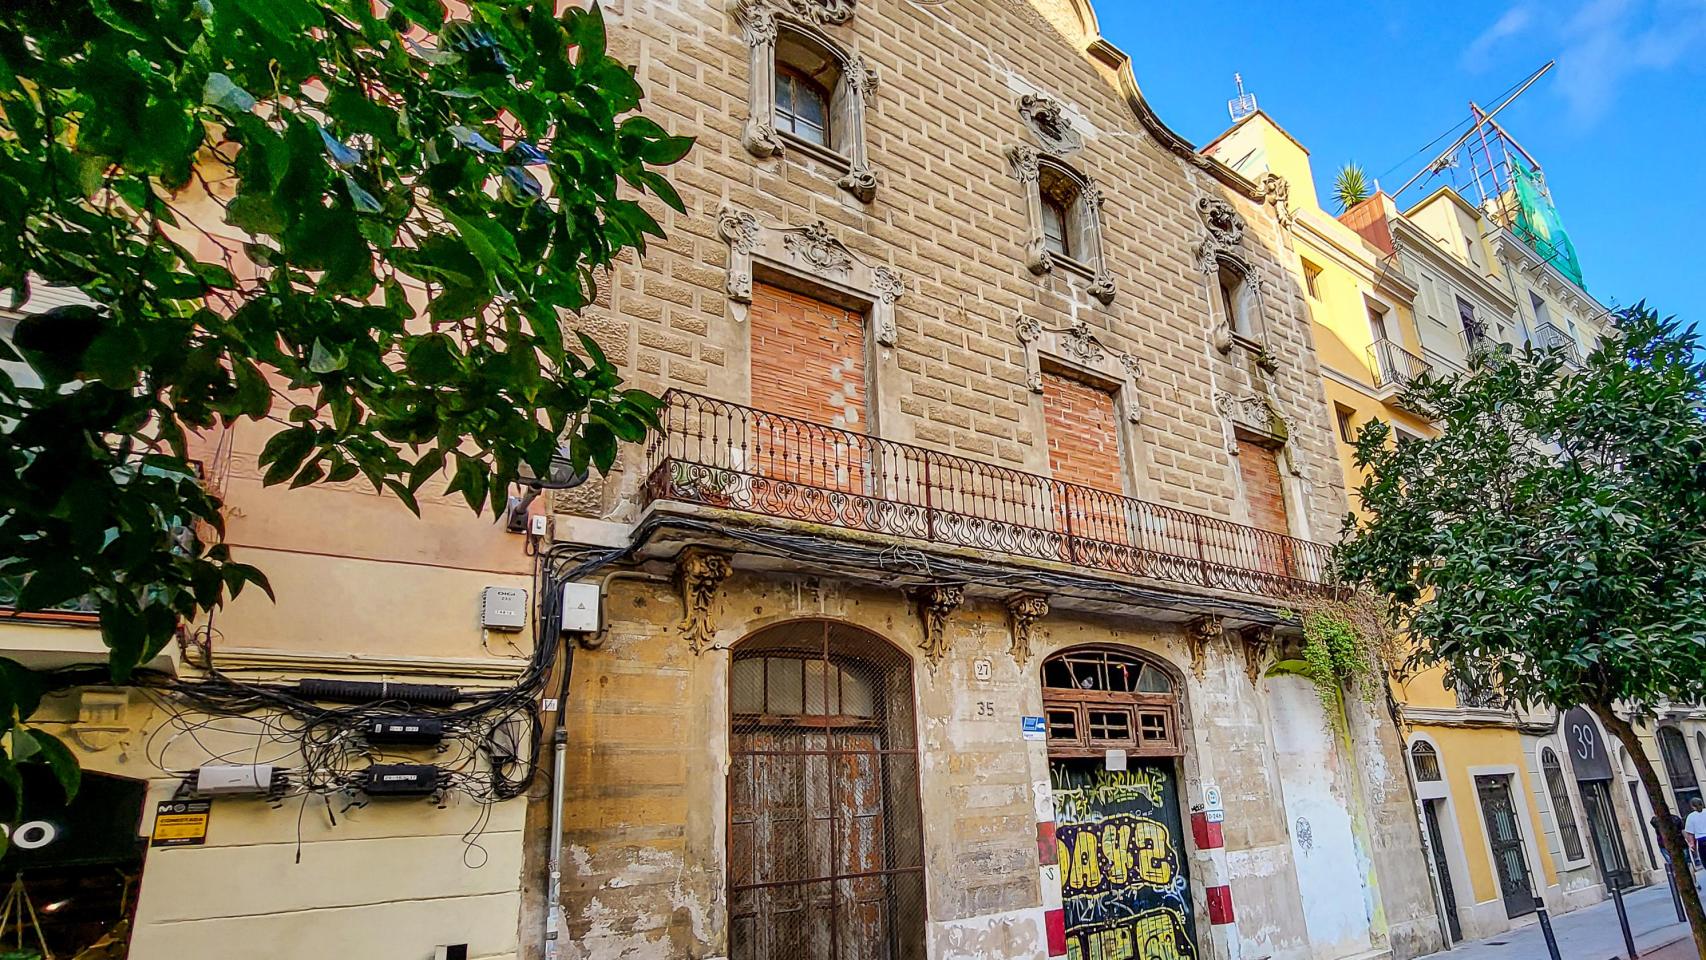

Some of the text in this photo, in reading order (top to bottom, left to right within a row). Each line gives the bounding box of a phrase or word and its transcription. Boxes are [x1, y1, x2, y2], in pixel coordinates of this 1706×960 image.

[977, 663, 989, 676] 27
[977, 701, 995, 717] 35
[1572, 724, 1595, 760] 39
